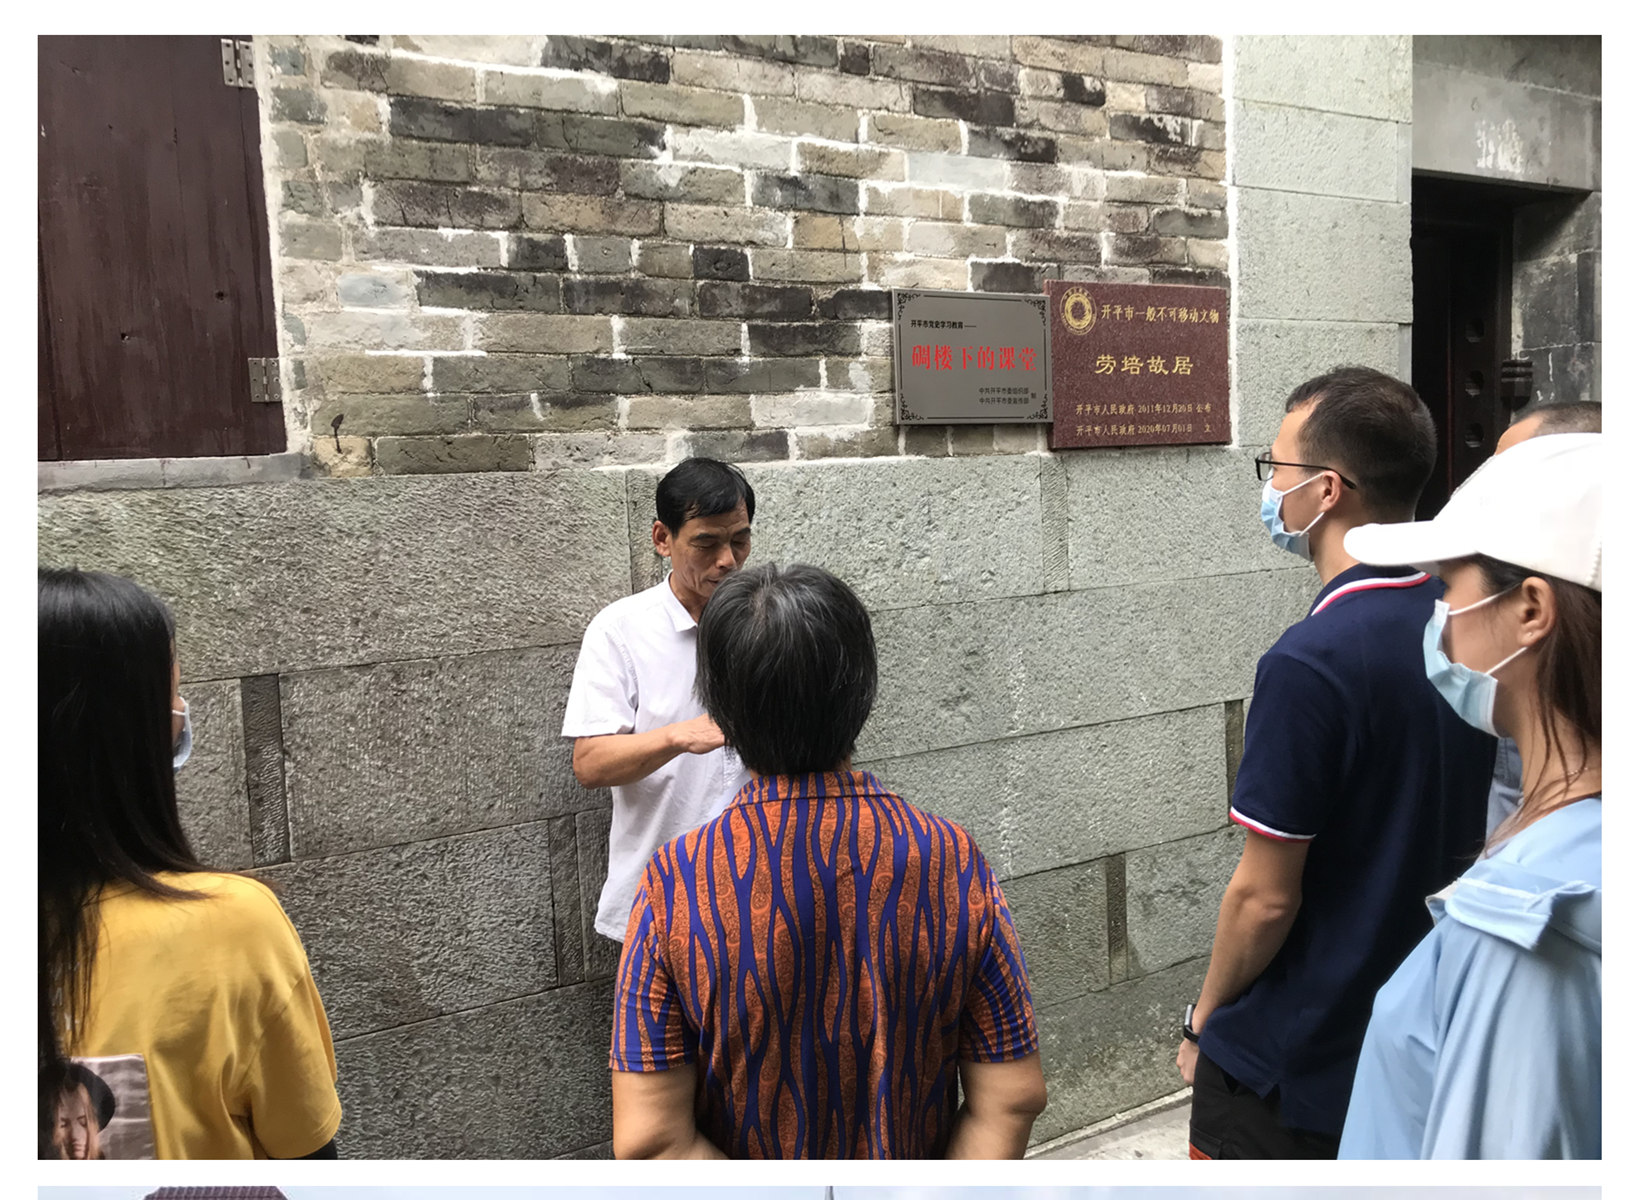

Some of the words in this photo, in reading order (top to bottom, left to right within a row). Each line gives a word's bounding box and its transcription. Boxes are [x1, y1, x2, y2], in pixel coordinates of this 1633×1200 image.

[1101, 304, 1220, 324] 开平市一般不可移动文物
[911, 344, 1038, 371] 碉楼下的课堂
[1095, 354, 1194, 376] 劳培故居
[1075, 403, 1135, 416] 开平市人民政府
[1076, 424, 1135, 436] 开平市人民政府
